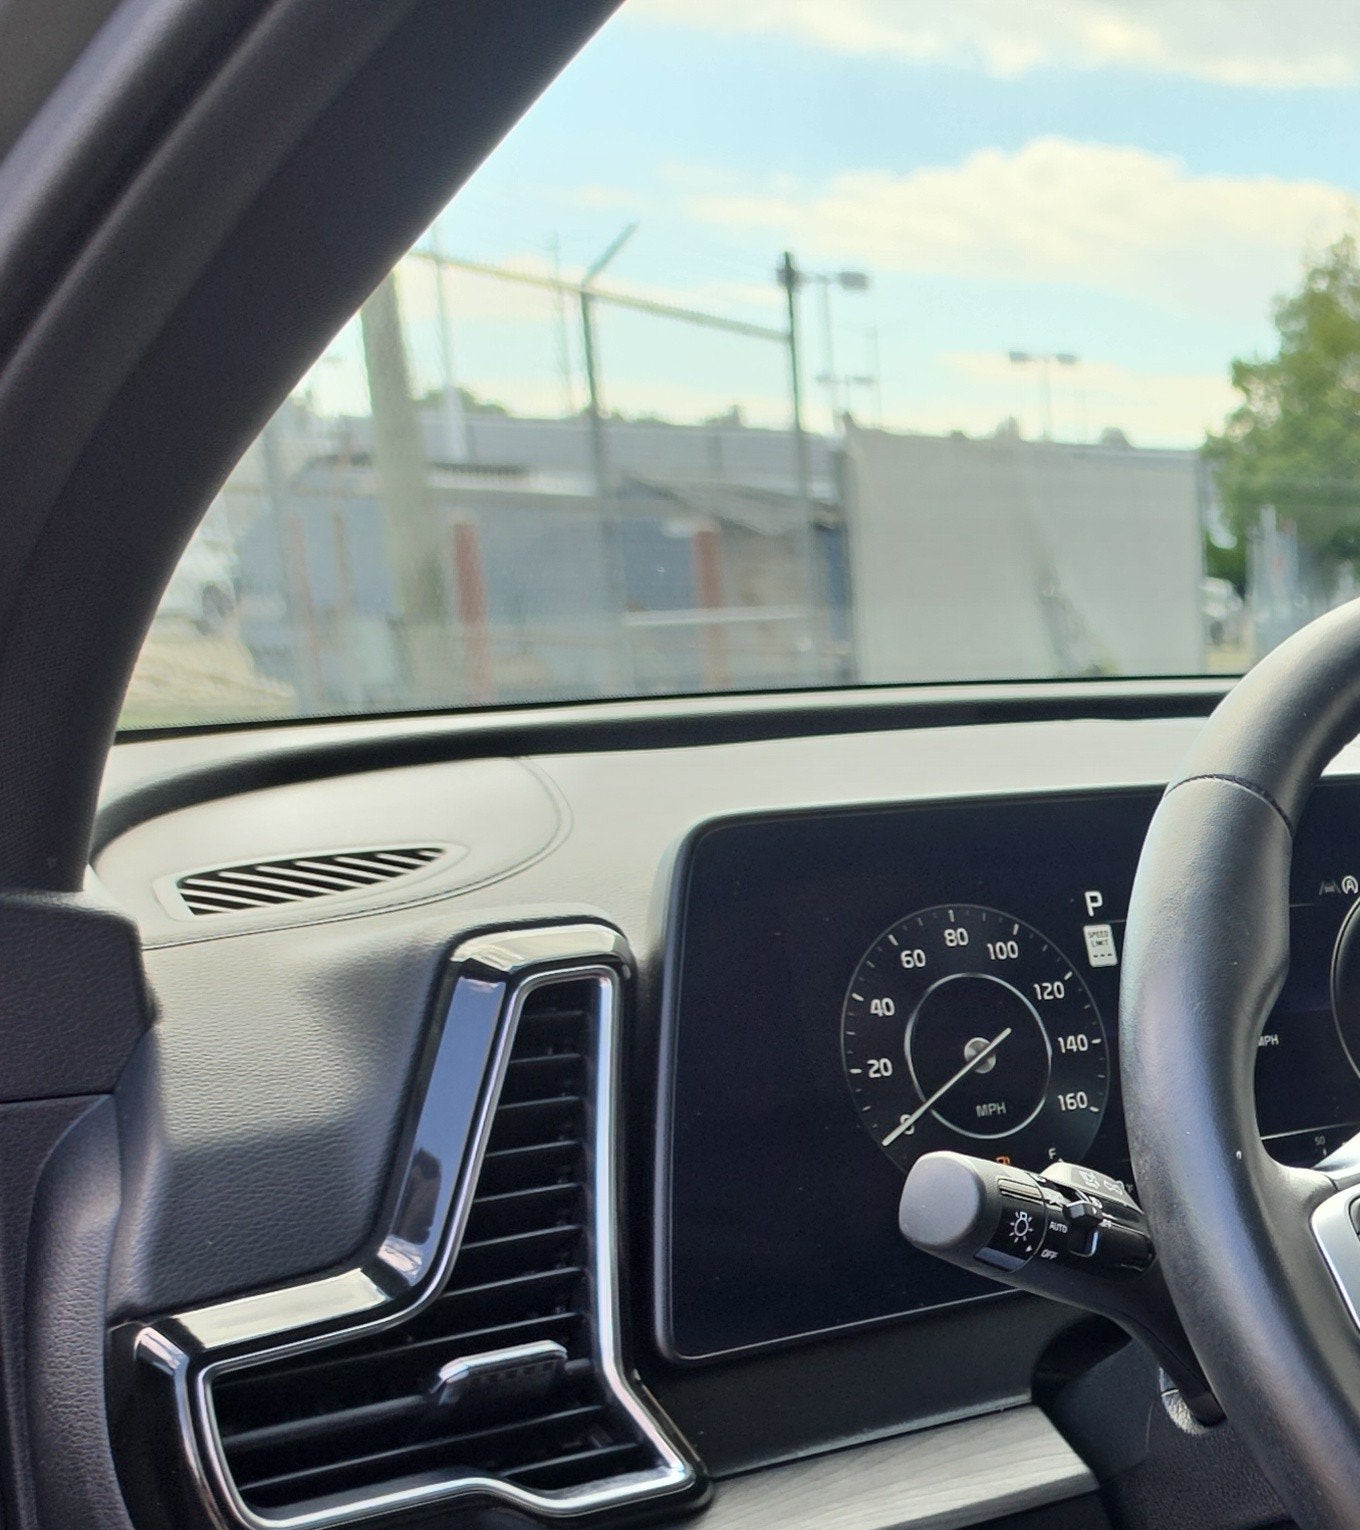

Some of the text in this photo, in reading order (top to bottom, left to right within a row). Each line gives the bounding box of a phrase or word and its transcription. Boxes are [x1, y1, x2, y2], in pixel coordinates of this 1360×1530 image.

[1085, 890, 1103, 917] P
[943, 927, 969, 947] 80
[900, 949, 926, 969] 60
[986, 940, 1019, 960] 100
[1033, 982, 1065, 1000] 120
[869, 997, 896, 1018] 40
[1057, 1033, 1089, 1054] 140
[866, 1057, 893, 1079] 20
[975, 1102, 1007, 1118] MPH
[1057, 1091, 1089, 1111] 160
[1048, 1147, 1056, 1160] F
[1048, 1221, 1069, 1234] AUTO
[1040, 1248, 1059, 1260] OFF
